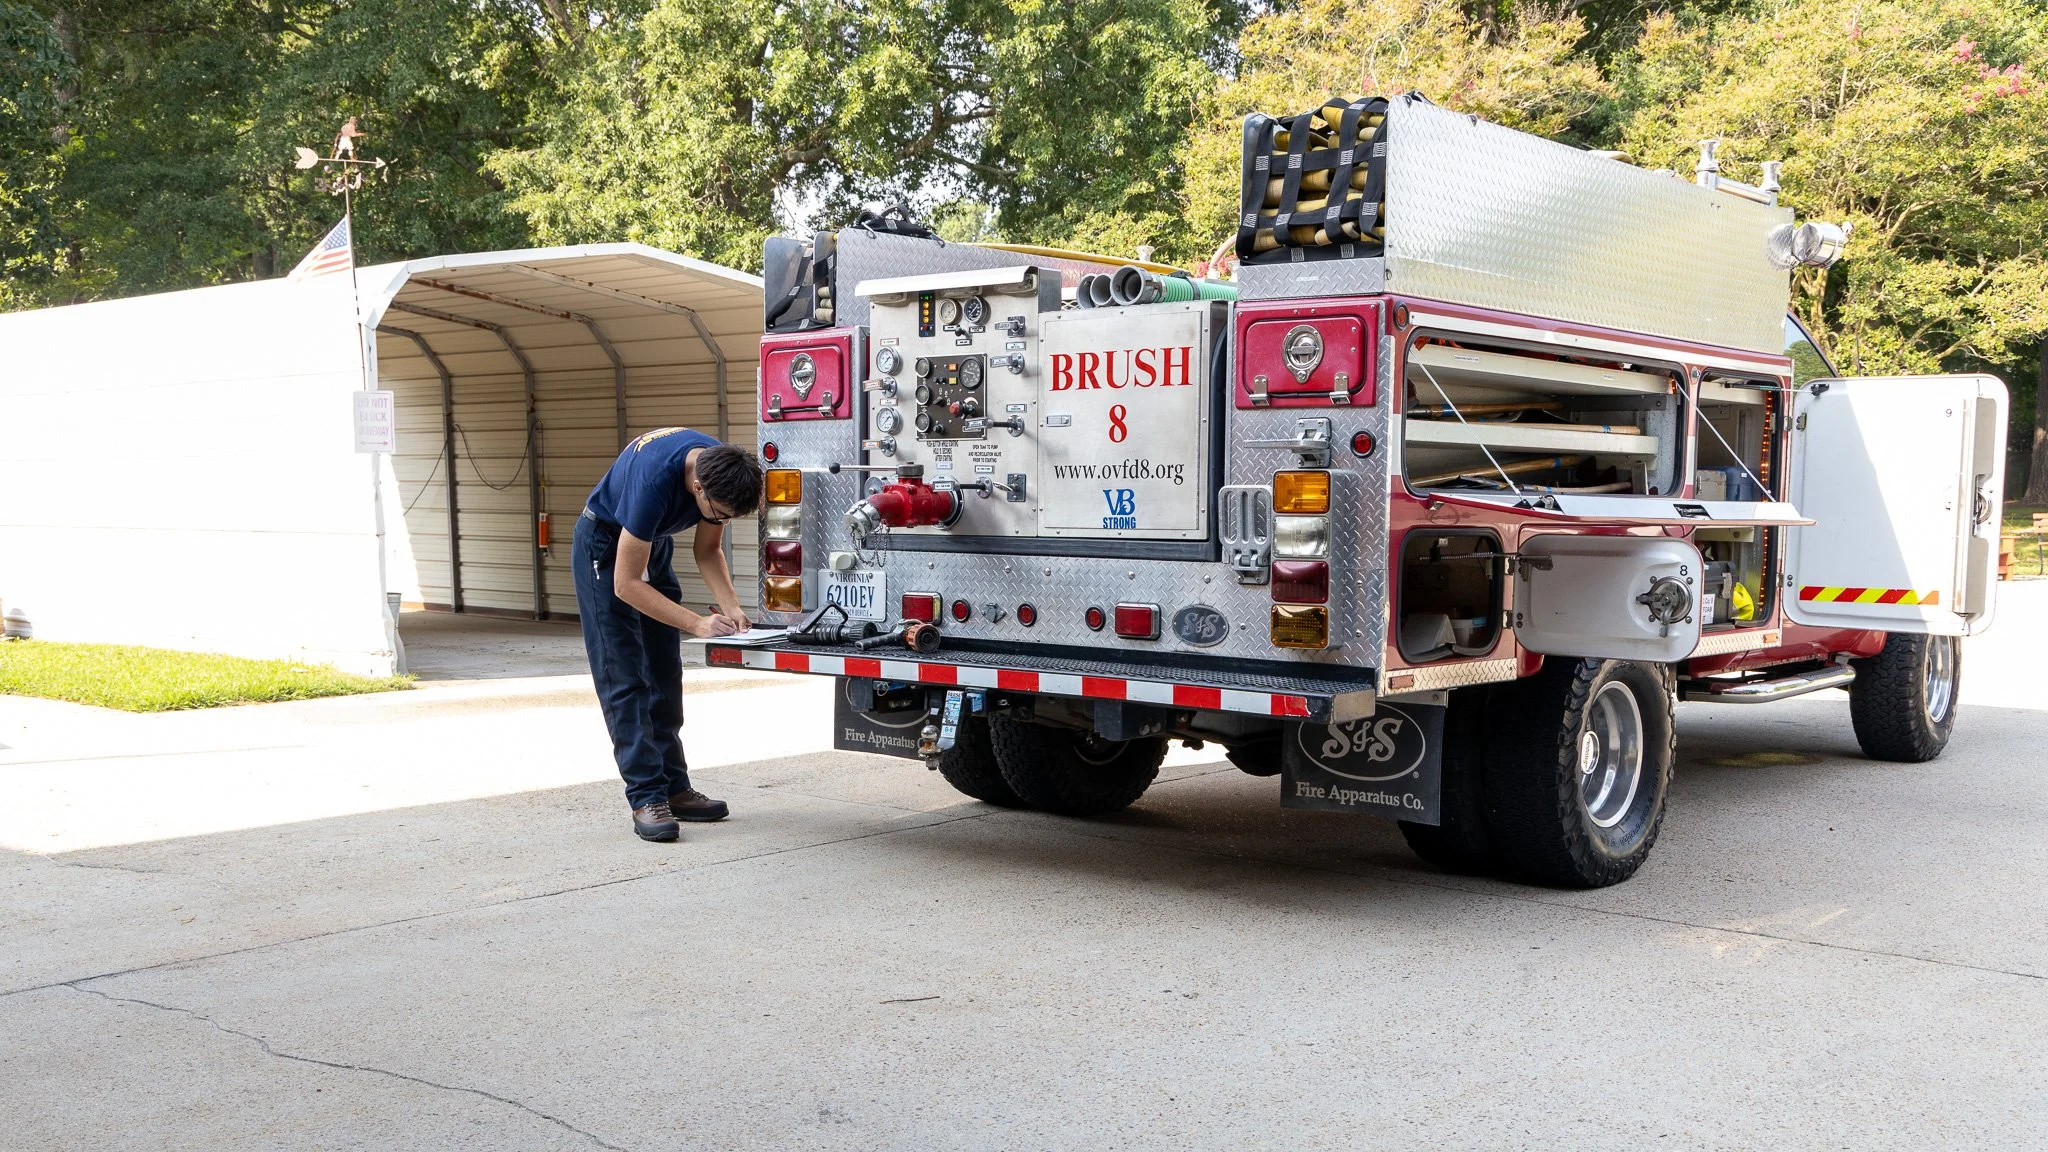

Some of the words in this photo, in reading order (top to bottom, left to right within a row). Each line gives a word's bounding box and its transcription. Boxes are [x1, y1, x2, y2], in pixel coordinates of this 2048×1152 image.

[1049, 346, 1194, 391] BRUSH
[371, 397, 388, 408] NOT
[359, 411, 388, 422] BLOCK
[1108, 404, 1128, 443] 8
[1054, 458, 1185, 485] www.ovfd8.org
[1102, 488, 1136, 516] VB
[1102, 516, 1136, 530] STRONG
[835, 572, 870, 583] VIRGINIA
[1680, 564, 1688, 576] 8
[826, 584, 875, 608] 6210EV
[1181, 612, 1220, 639] S&S
[844, 727, 865, 741] Fire
[867, 730, 915, 749] Apparatus
[1320, 717, 1404, 762] S&S
[1295, 781, 1325, 799] Fire
[1328, 784, 1400, 807] Apparatus
[1402, 793, 1425, 810] Co.
